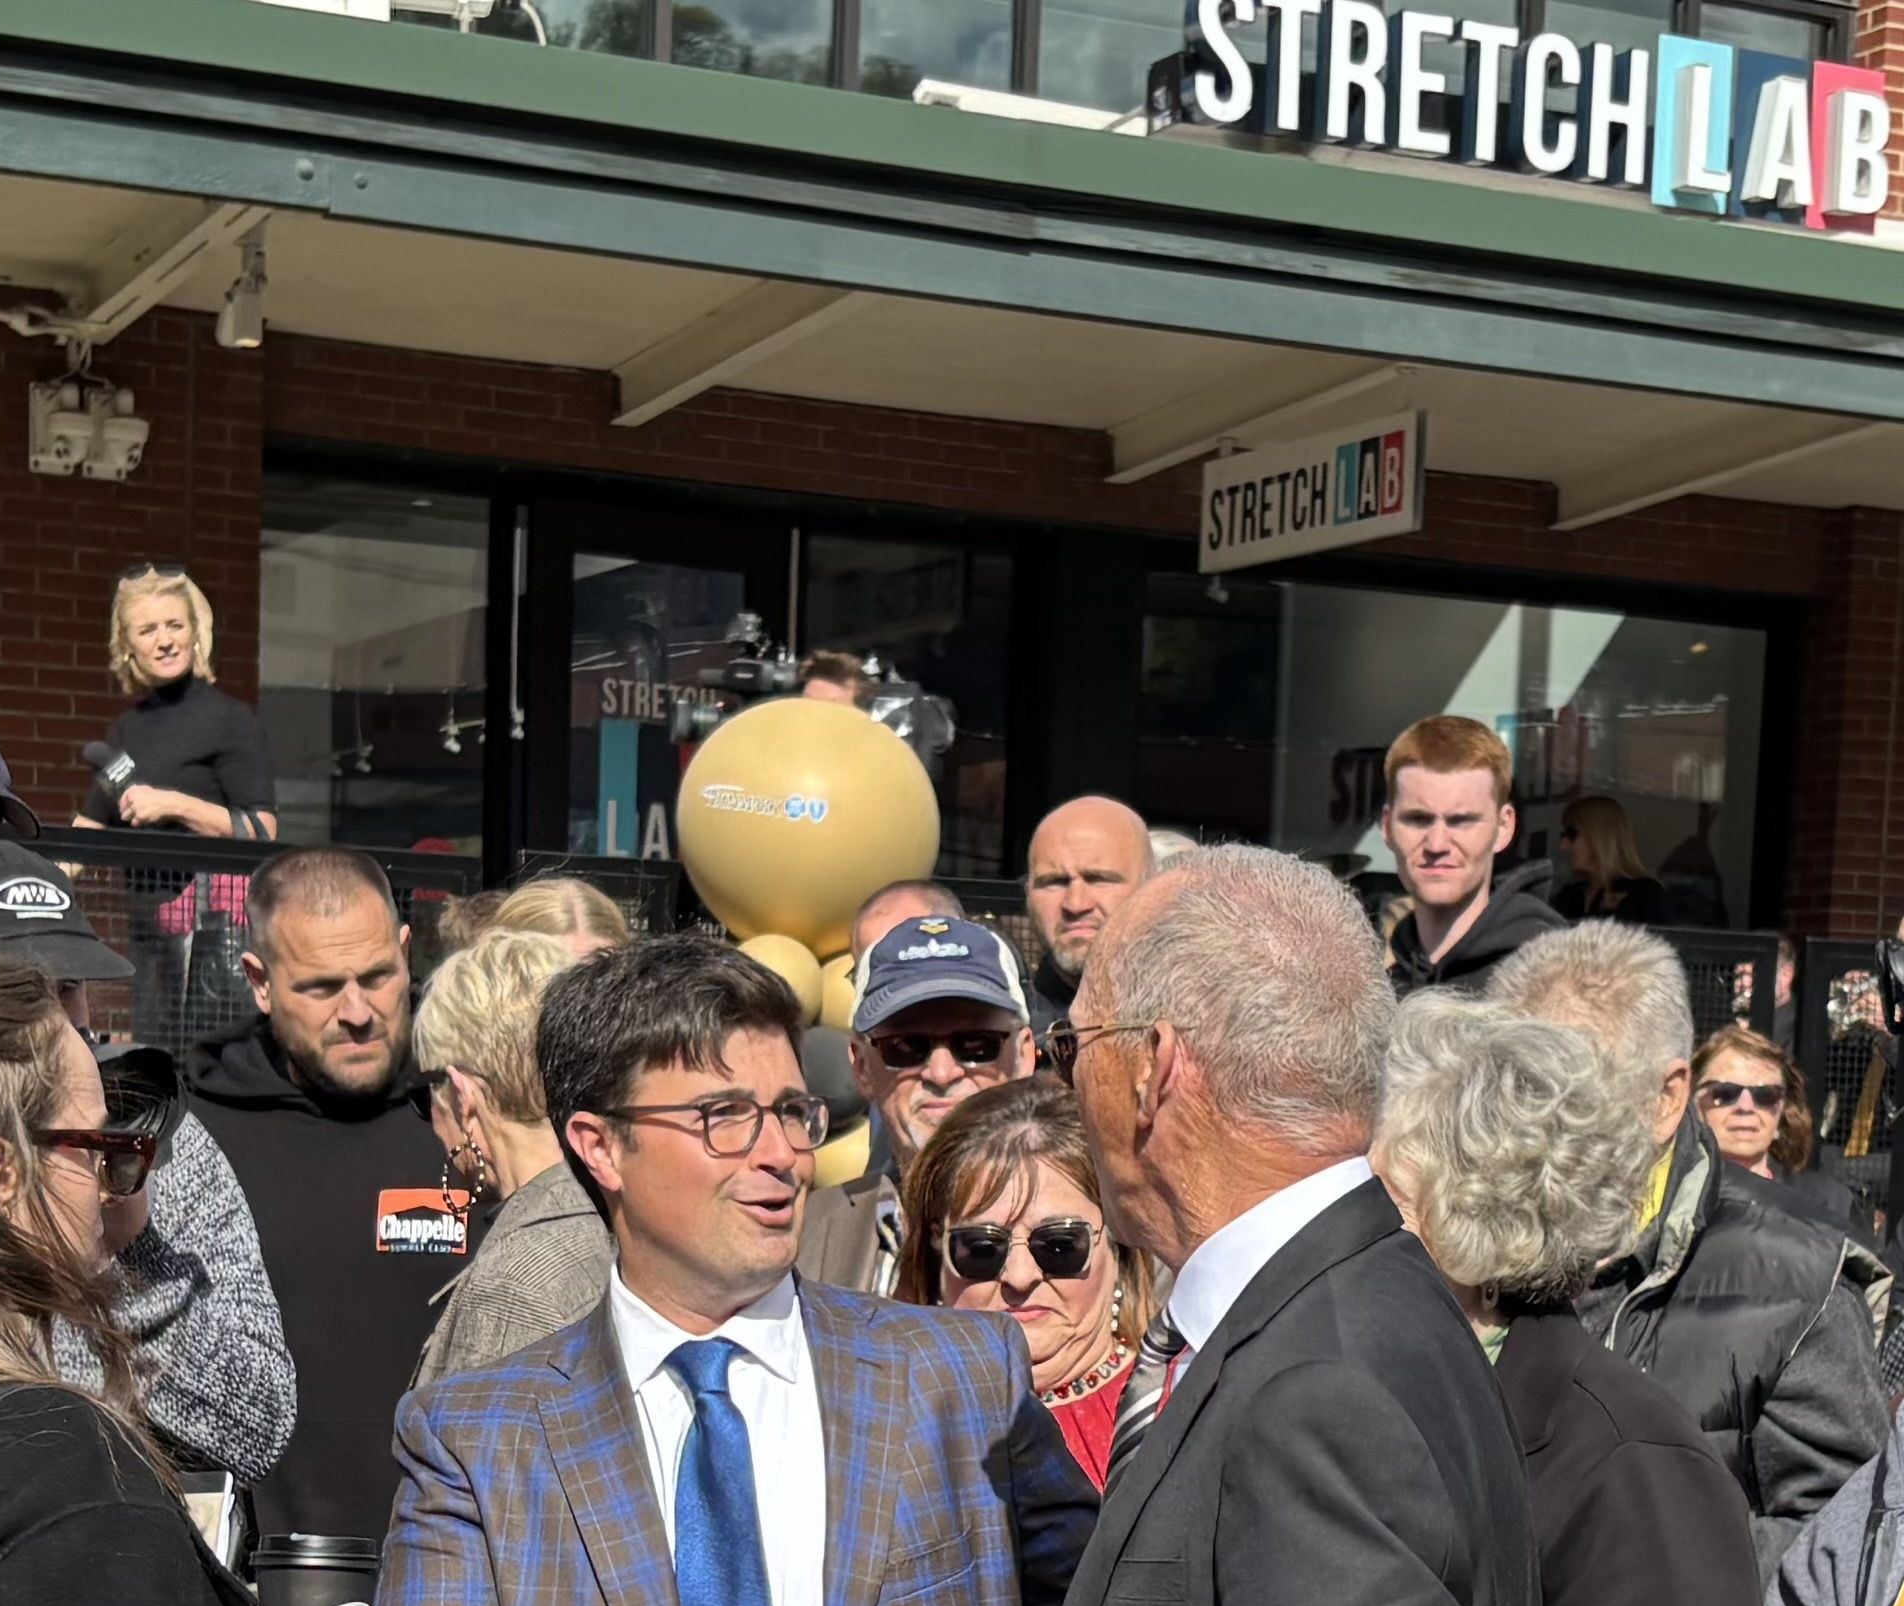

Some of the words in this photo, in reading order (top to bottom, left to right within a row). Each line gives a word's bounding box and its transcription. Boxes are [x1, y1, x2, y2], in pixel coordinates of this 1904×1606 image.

[1208, 461, 1327, 551] STRETCH
[1337, 446, 1403, 518] LAB
[606, 798, 672, 862] LA
[380, 1213, 466, 1243] Chappelle
